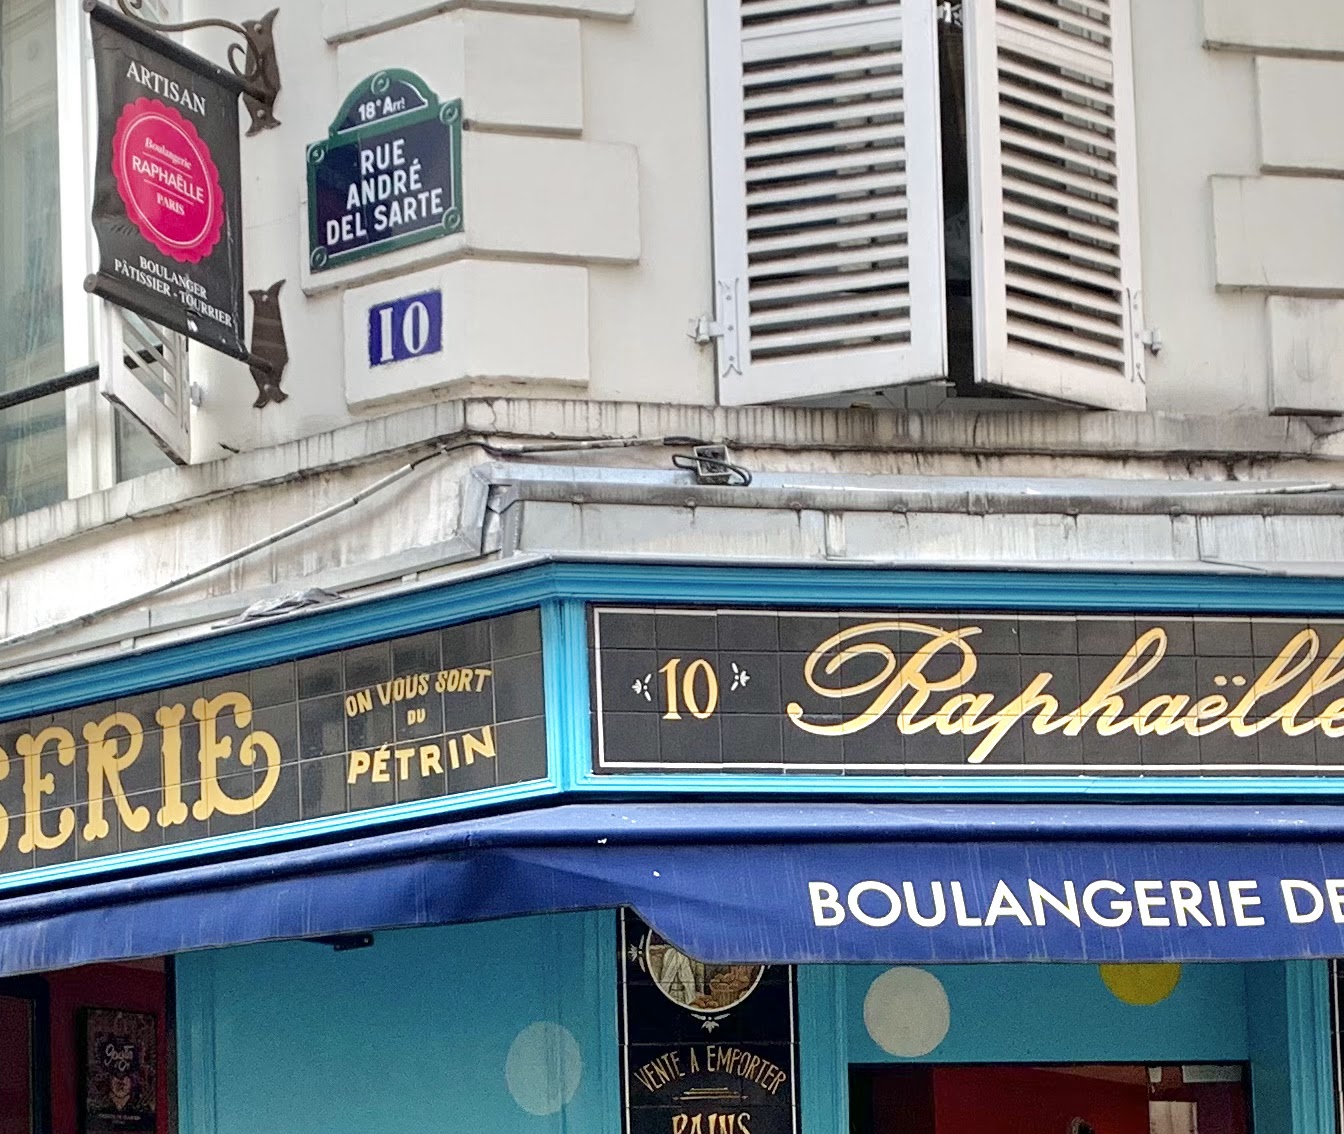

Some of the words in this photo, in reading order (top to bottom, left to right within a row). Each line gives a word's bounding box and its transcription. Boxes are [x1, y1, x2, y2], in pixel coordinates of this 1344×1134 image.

[126, 60, 206, 116] ARTISAN
[144, 137, 192, 170] Boulangerie
[360, 138, 406, 173] RUE
[132, 155, 204, 204] RAPHAËLLE
[157, 193, 185, 216] PARIS
[346, 158, 422, 211] ANDRÉ
[326, 212, 367, 247] DEL
[373, 188, 445, 230] SARTE
[114, 258, 171, 297] PÂTISSIER
[179, 290, 232, 328] TOURRIER
[140, 256, 208, 300] BOULANGER
[379, 300, 430, 362] 10
[346, 689, 373, 717] ON
[376, 673, 430, 706] VOUS
[435, 668, 492, 693] SORT
[658, 656, 720, 722] 10
[407, 708, 426, 726] DU
[347, 725, 496, 784] PÉTRIN
[808, 878, 1266, 930] BOULANGERIE
[633, 1051, 686, 1092] VENTE
[690, 1047, 700, 1073] A
[706, 1045, 787, 1095] EMPORTER
